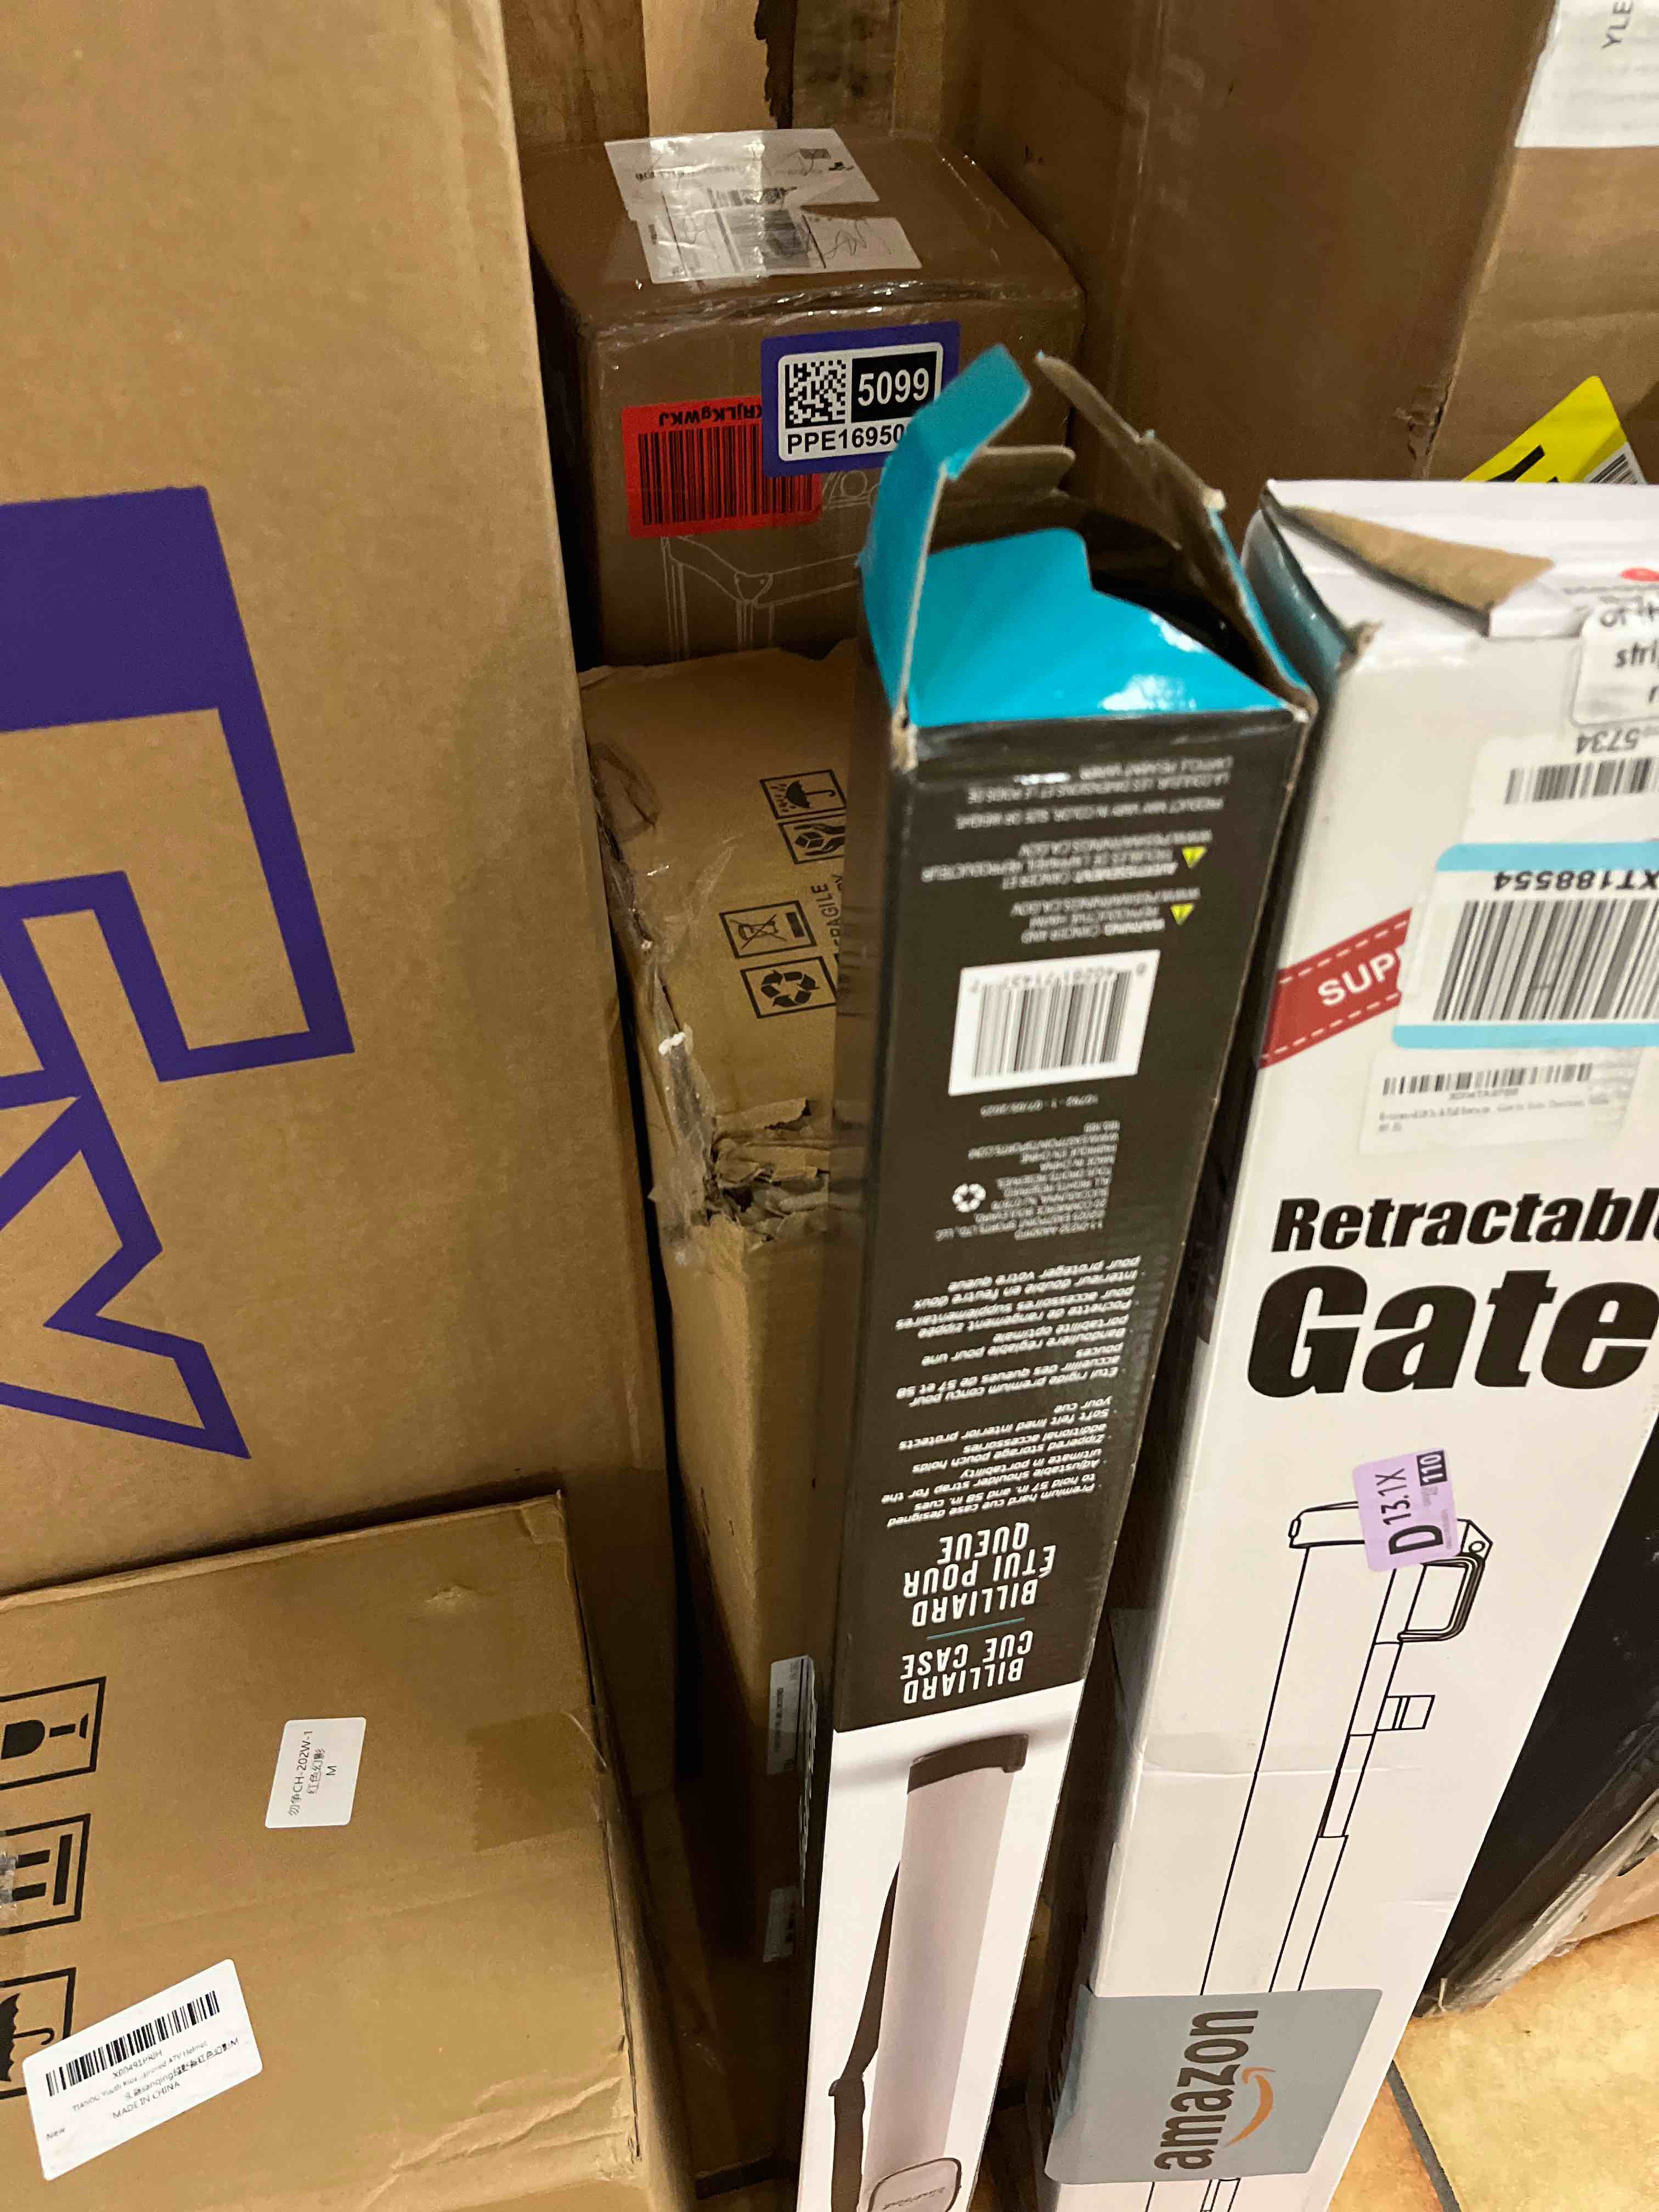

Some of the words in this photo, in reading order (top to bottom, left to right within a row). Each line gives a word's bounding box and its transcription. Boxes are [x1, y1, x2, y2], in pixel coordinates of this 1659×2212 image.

[857, 368, 929, 407] 5099
[658, 403, 763, 427] RjLKgWKJ
[1317, 953, 1396, 1006] SUP
[1246, 1265, 1659, 1398] Gate
[1050, 1414, 1075, 1425] felt
[1078, 1409, 1109, 1421] Soft
[961, 1424, 1013, 1440] interior
[1015, 1419, 1047, 1432] lined
[1042, 1424, 1107, 1441] additional
[899, 1431, 959, 1450] protects
[963, 1434, 1040, 1454] accessories
[1047, 1434, 1105, 1451] Zippered
[951, 1452, 991, 1467] pouch
[993, 1444, 1045, 1460] storage
[1048, 1448, 1102, 1464] ultimate
[912, 1460, 947, 1473] holds
[960, 1459, 1030, 1479] portability
[1033, 1458, 1045, 1467] in
[1033, 1459, 1100, 1477] Adjustable
[1420, 1452, 1445, 1485] 110
[973, 1471, 1030, 1486] shoulder
[1051, 1476, 1079, 1488] hold
[1081, 1474, 1094, 1482] to
[908, 1488, 929, 1498] for
[934, 1481, 970, 1494] strap
[986, 1488, 1011, 1499] and
[1016, 1485, 1029, 1493] in.
[1031, 1481, 1049, 1492] 57
[1041, 1483, 1094, 1499] Premium
[882, 1492, 904, 1504] the
[914, 1499, 944, 1510] cues
[950, 1496, 963, 1504] in.
[966, 1492, 984, 1503] 58
[981, 1499, 1005, 1510] cue
[1007, 1492, 1037, 1506] hard
[1375, 1468, 1412, 1527] 13.1X
[948, 1504, 979, 1516] case
[887, 1510, 945, 1527] designed
[936, 1522, 1030, 1564] QUEUE
[1388, 1524, 1443, 1556] D
[992, 1545, 1056, 1581] ÉTUI
[902, 1559, 978, 1598] POUR
[912, 1578, 1038, 1627] BILLIARD
[983, 1630, 1033, 1662] CUE
[900, 1644, 968, 1679] CASE
[902, 1656, 1024, 1704] BILLIARD
[326, 1765, 337, 1776] M
[153, 2081, 180, 2098] CHINA
[1154, 2010, 1259, 2171] amazon
